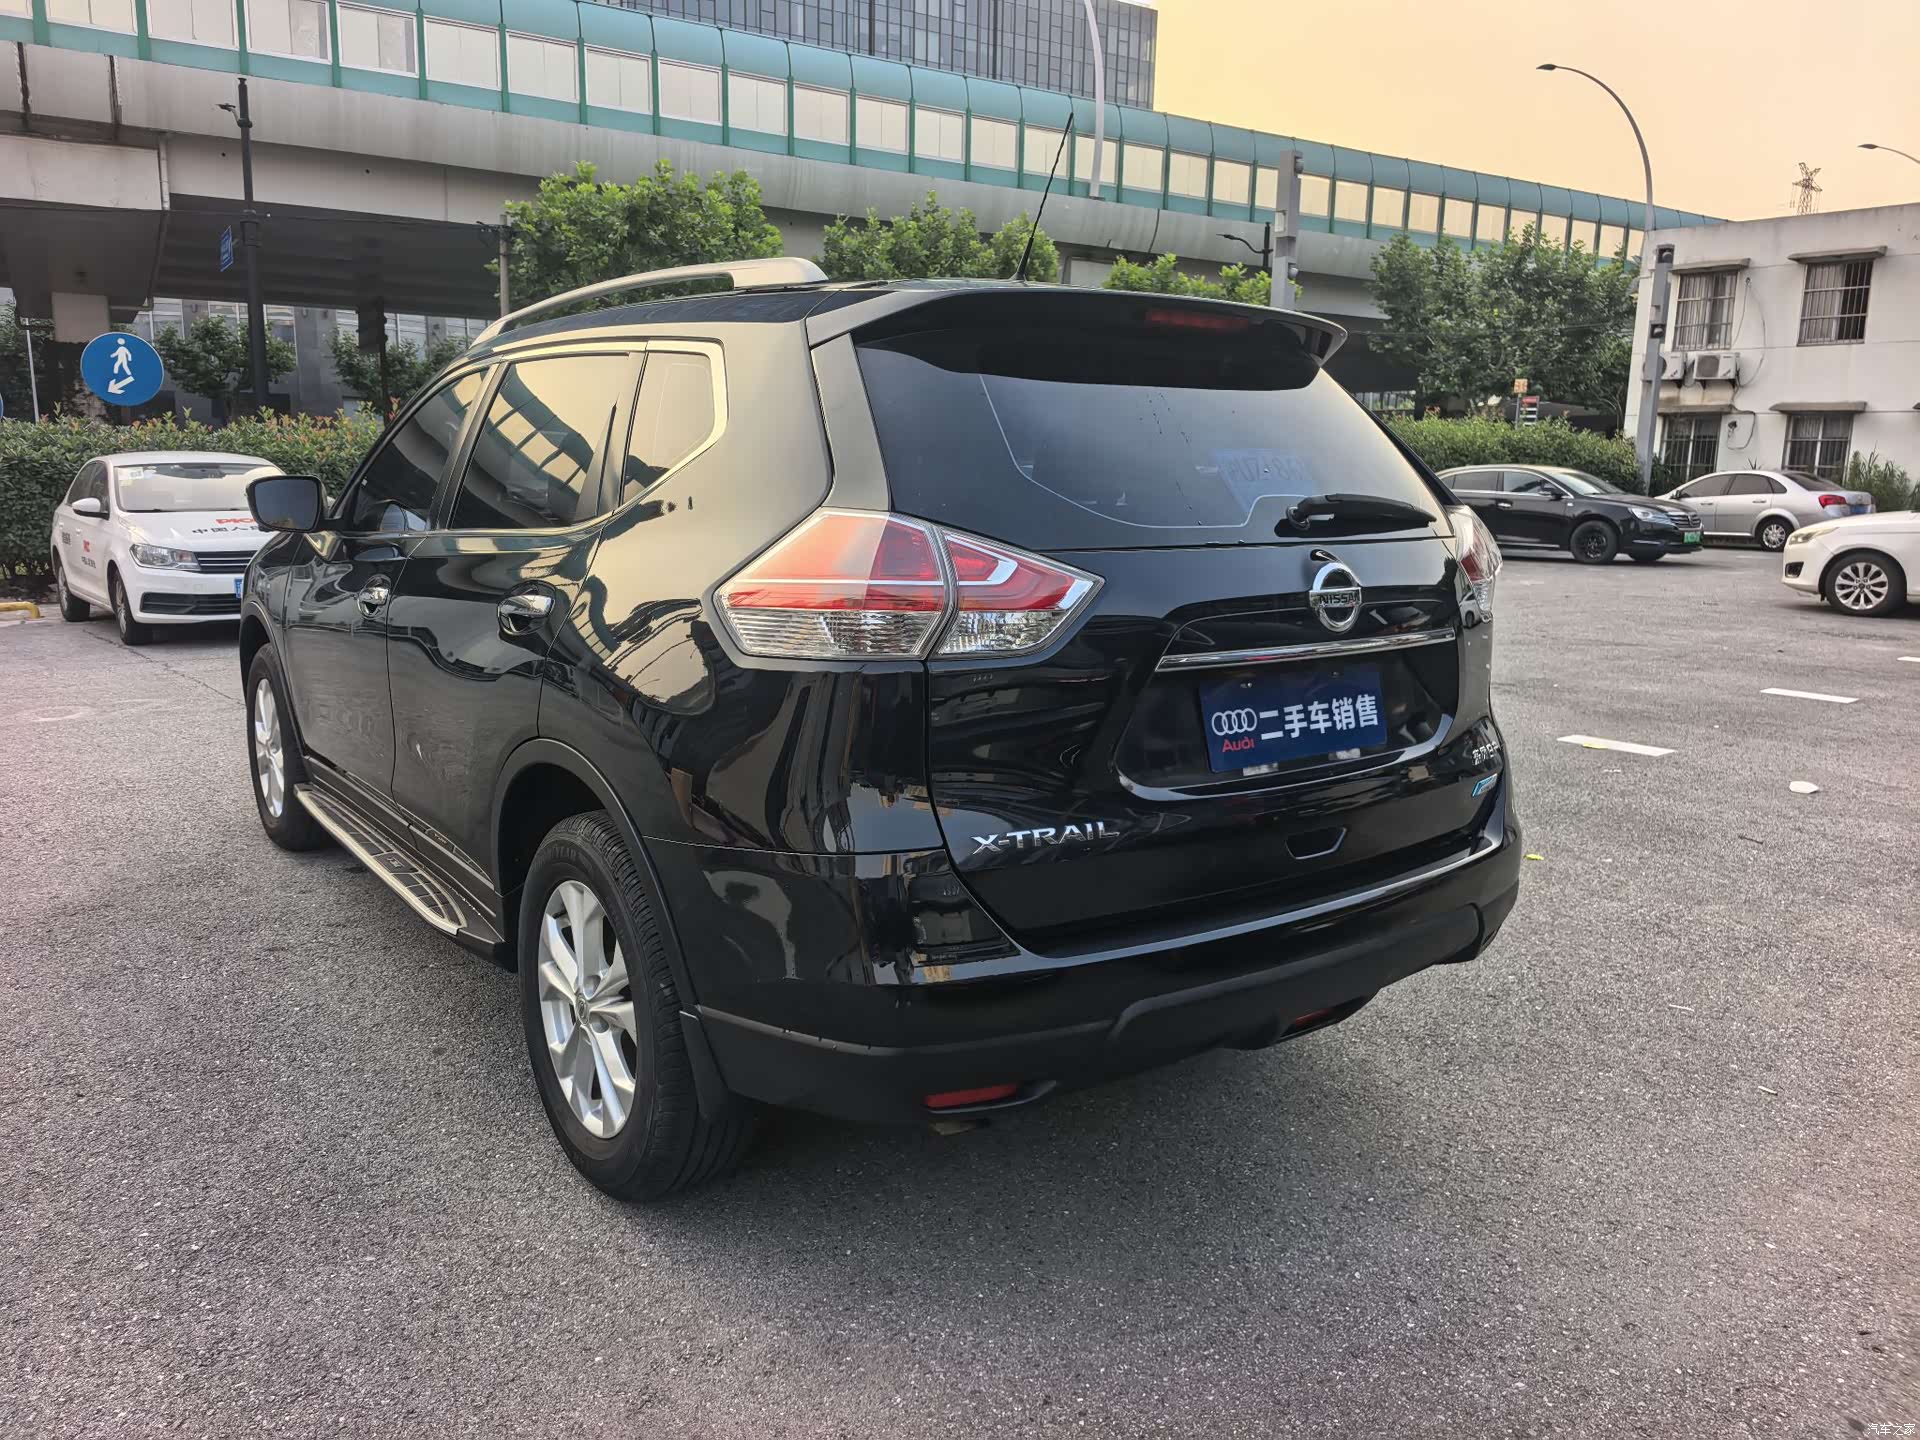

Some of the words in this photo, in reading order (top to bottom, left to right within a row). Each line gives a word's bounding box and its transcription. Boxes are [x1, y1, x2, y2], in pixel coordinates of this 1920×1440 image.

[1259, 693, 1379, 741] 二手车销售
[1222, 736, 1256, 753] Audi
[971, 821, 1121, 855] X-TRAIL
